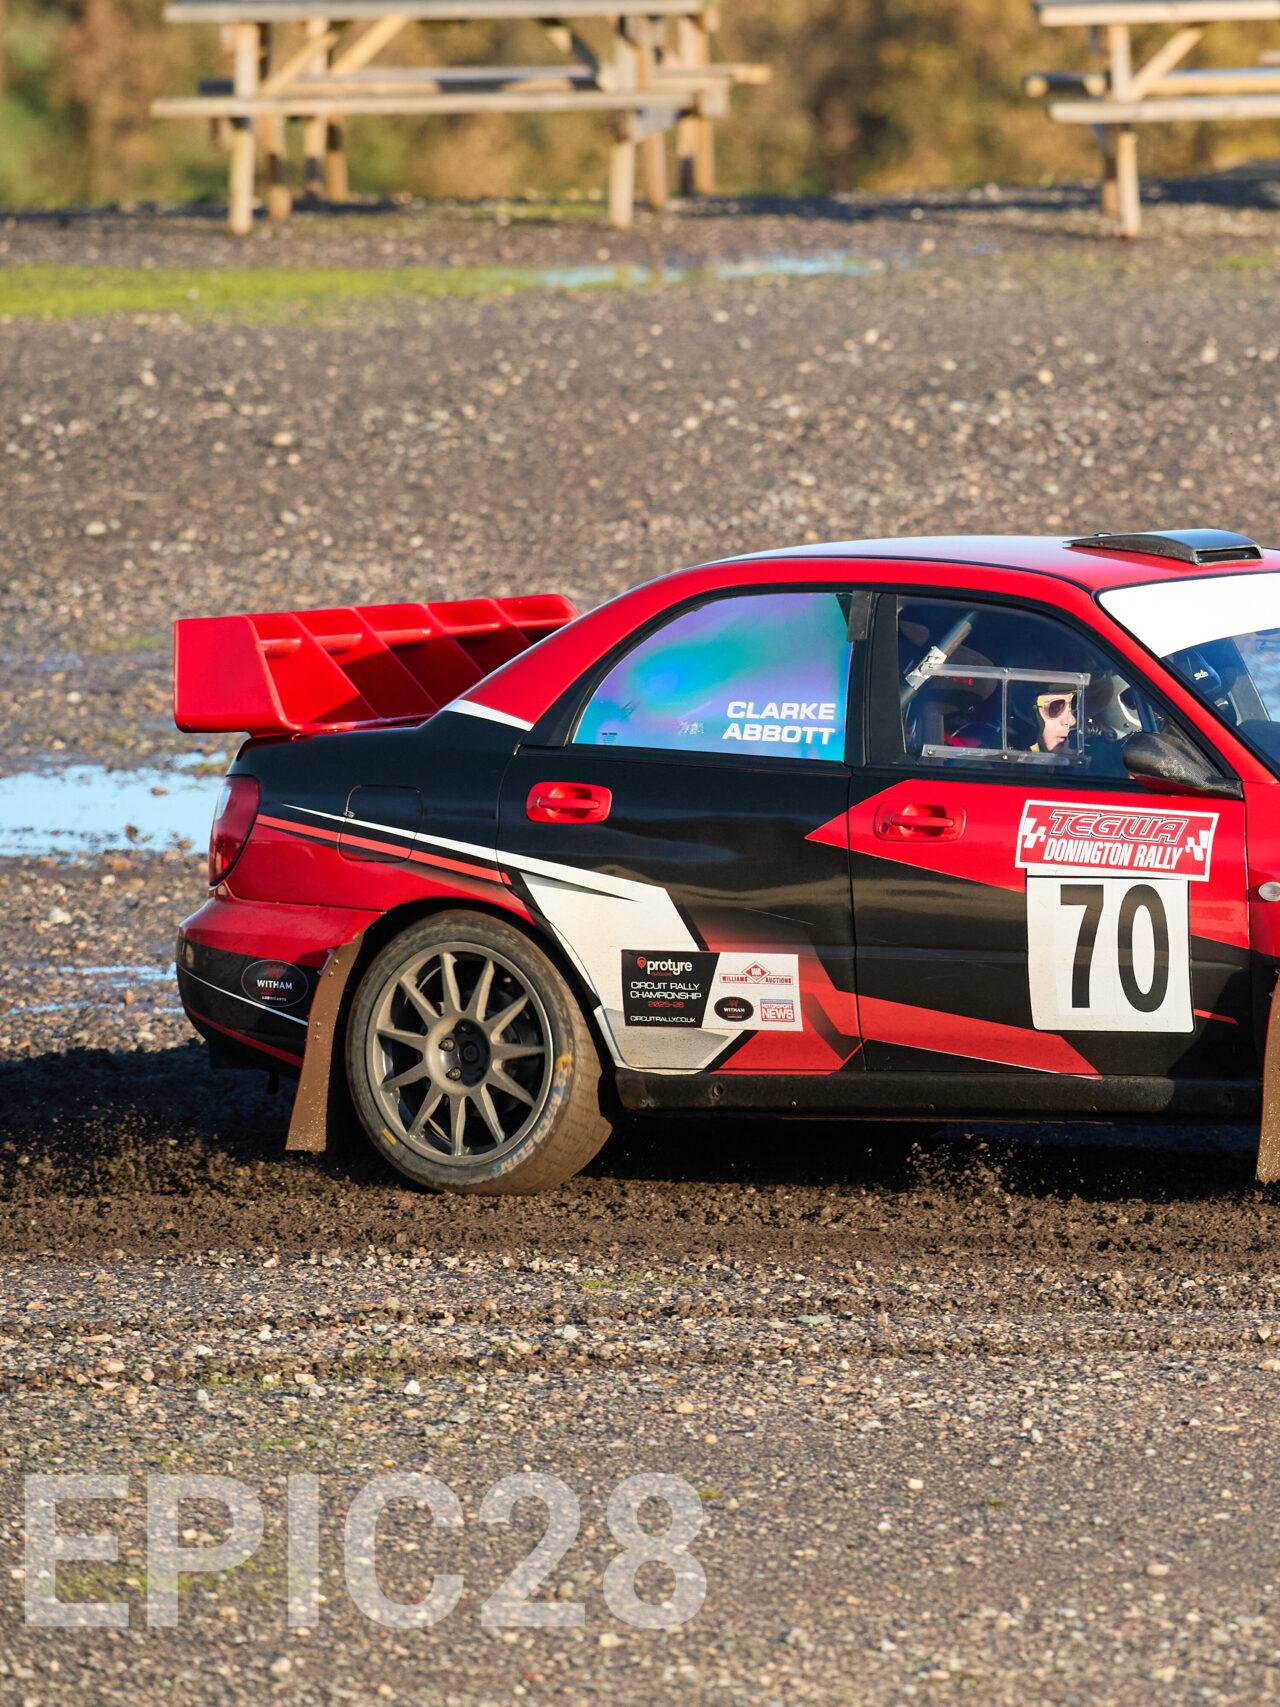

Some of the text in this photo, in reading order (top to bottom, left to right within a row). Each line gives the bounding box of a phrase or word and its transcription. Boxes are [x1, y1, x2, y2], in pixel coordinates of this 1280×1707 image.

[726, 701, 836, 721] CLARKE
[722, 722, 836, 745] ABBOTT
[1050, 808, 1188, 845] TEGIWA
[1043, 837, 1184, 871] DONINGTON RALLY
[1060, 883, 1169, 1013] 70
[646, 958, 693, 976] protyre
[256, 979, 293, 991] WITHAM
[630, 981, 700, 992] CIRCUIT RALLY
[765, 976, 792, 984] AUCTIONS
[630, 990, 702, 1000] CHAMPIONSHIP
[761, 1008, 794, 1020] NEWS
